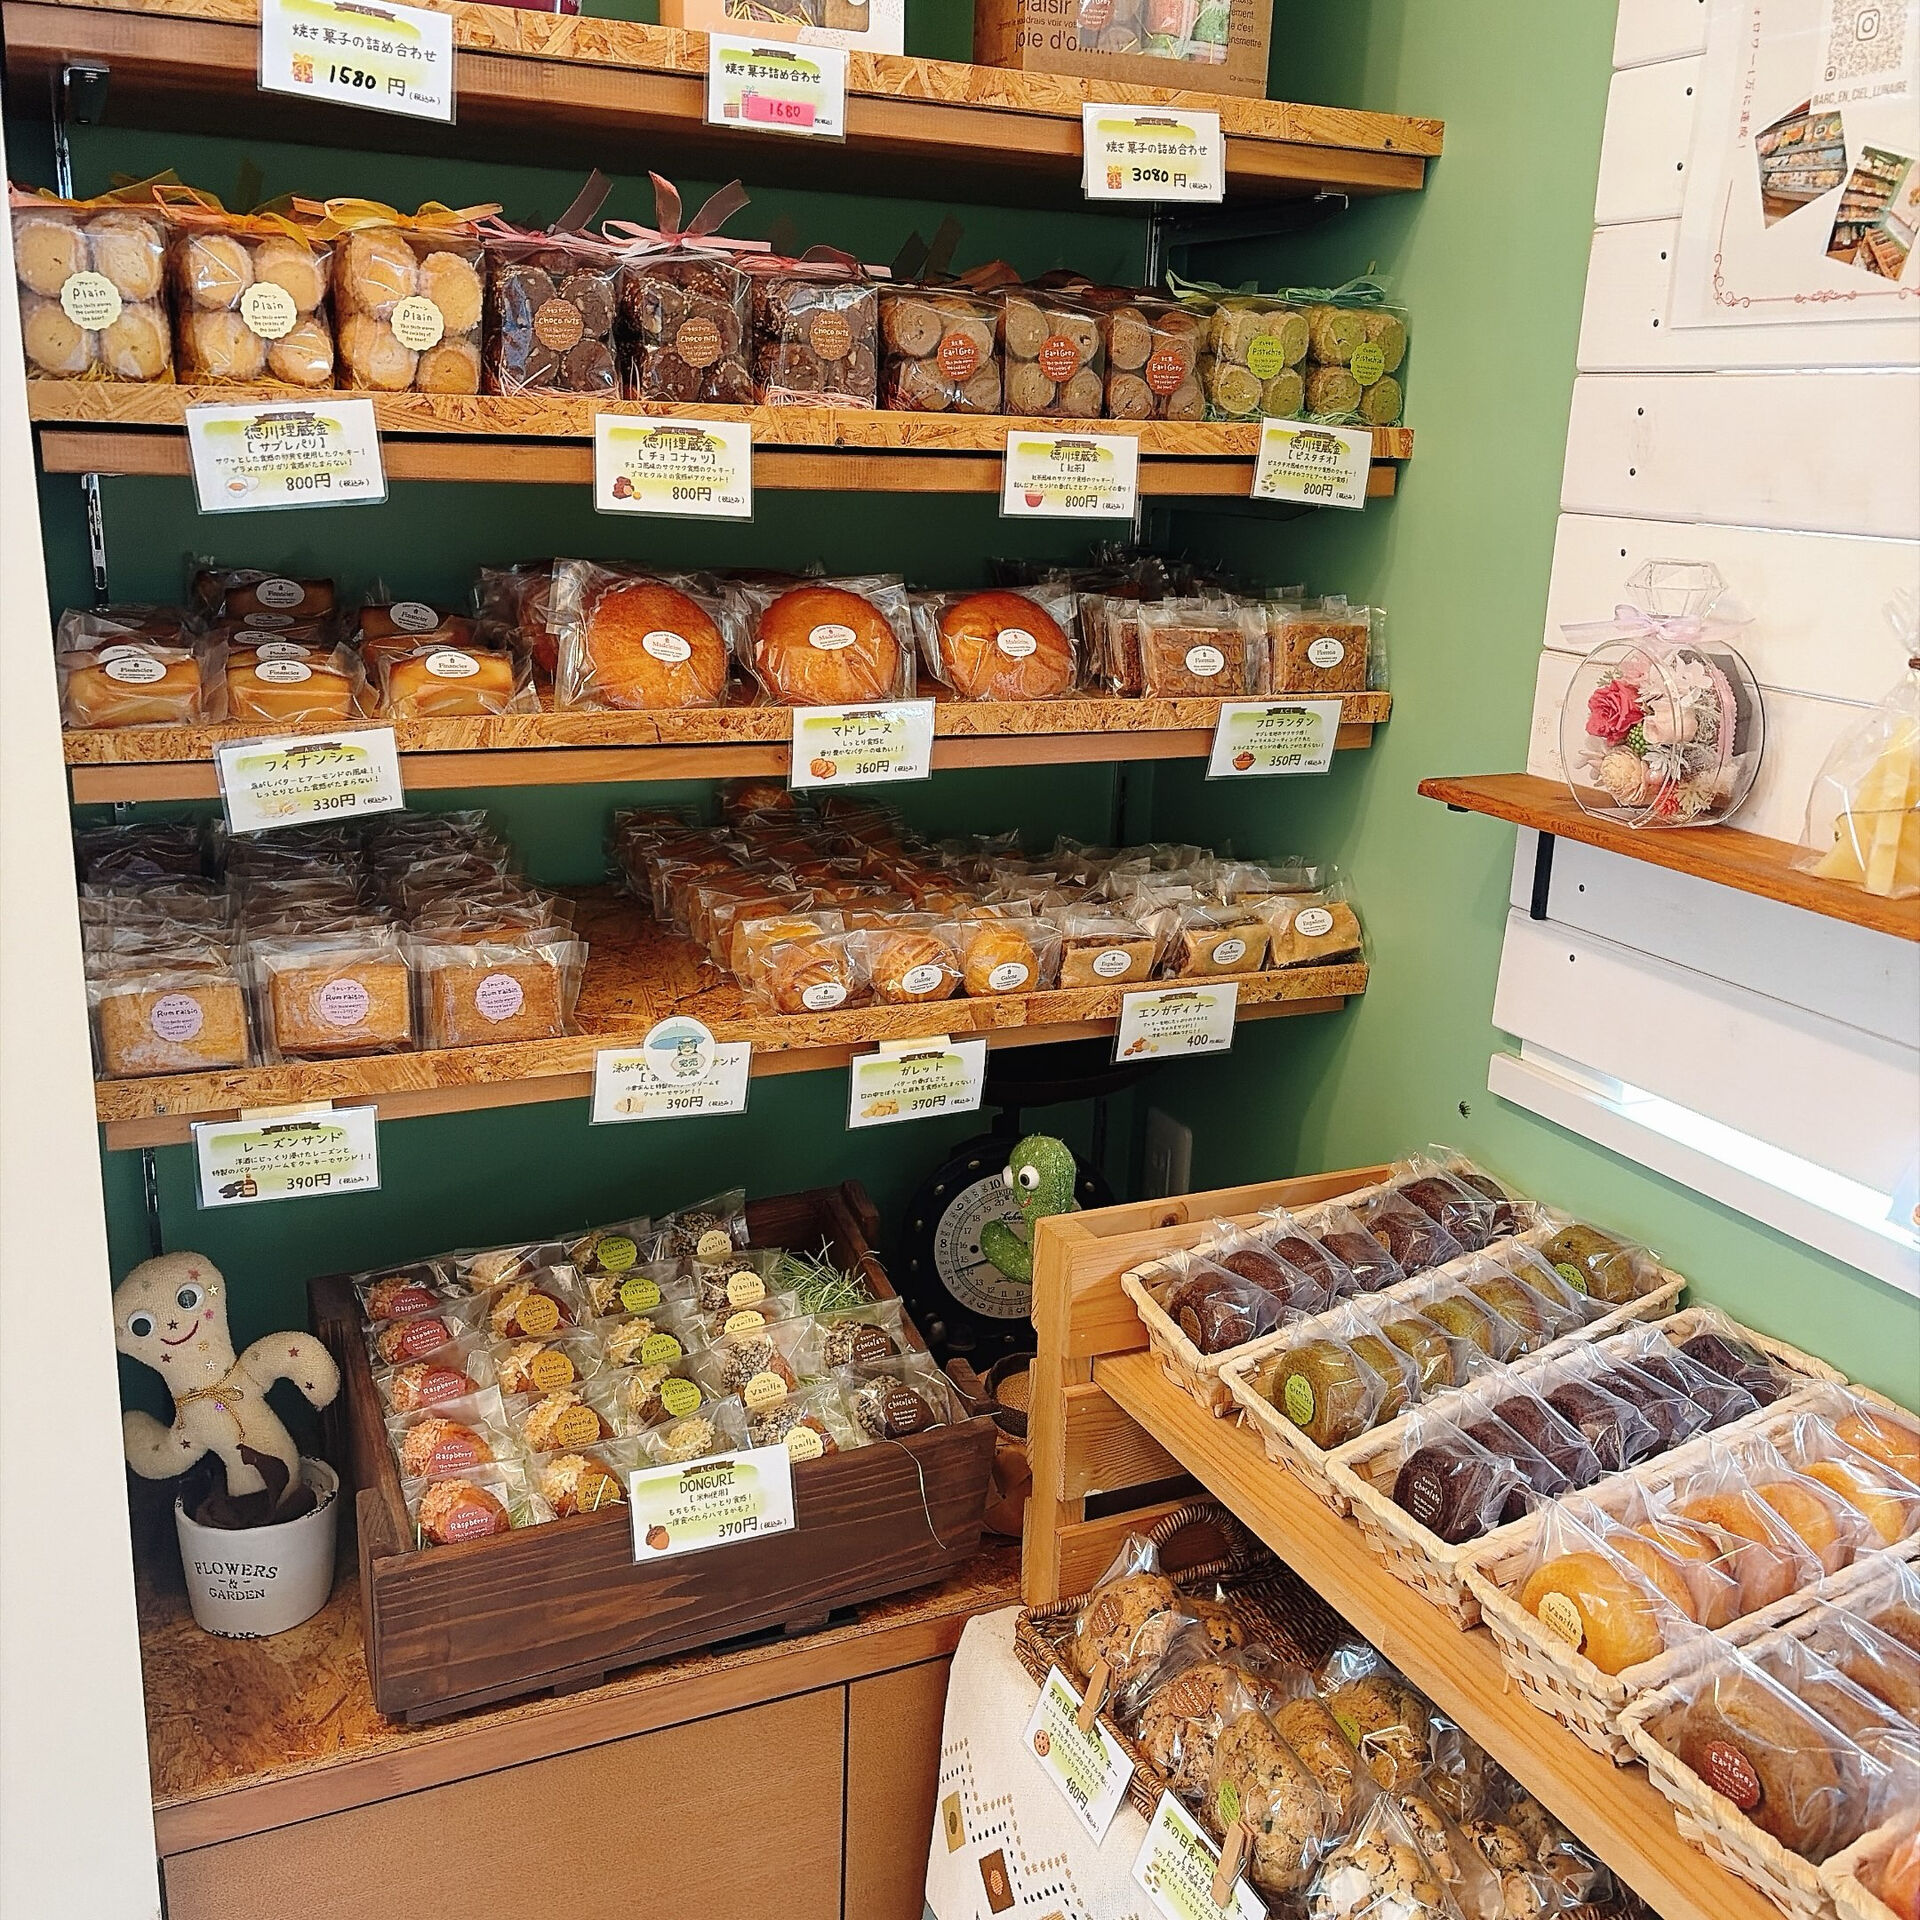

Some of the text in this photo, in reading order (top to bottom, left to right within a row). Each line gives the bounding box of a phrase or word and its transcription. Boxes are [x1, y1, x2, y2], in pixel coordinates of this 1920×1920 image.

[292, 23, 437, 62] 焼き菓子の詰め合わせ
[1015, 28, 1043, 53] joie
[329, 64, 376, 89] 1580
[387, 77, 406, 97] 円
[725, 63, 821, 83] 焼き菓子詰め合わせ
[769, 102, 801, 118] 1680
[1106, 141, 1209, 157] 焼き菓子の詰め合わせ
[1131, 167, 1170, 184] 3080
[1173, 172, 1187, 189] 円
[72, 287, 106, 299] Plain
[252, 299, 284, 311] Plain
[402, 309, 433, 322] Plain
[244, 421, 330, 440] 徳川埋蔵金
[642, 435, 717, 453] 徳川埋蔵金
[1290, 437, 1342, 455] 徳川埋蔵金
[637, 449, 716, 465] 【チョコナッツ】
[1050, 449, 1101, 462] 徳川埋蔵金
[1288, 449, 1338, 465] 【ピスタチオ】
[286, 473, 331, 491] 800円
[1303, 482, 1333, 497] 800円
[672, 486, 712, 501] 800円
[1065, 495, 1098, 508] 800円
[832, 723, 893, 737] マドレーヌ
[1256, 718, 1315, 729] フロランタン
[265, 752, 357, 772] フィナンシェ
[855, 760, 890, 774] 360円
[1268, 754, 1302, 767] 350円
[313, 794, 356, 811] 330円
[325, 993, 343, 1001] Rum
[481, 990, 497, 998] Rum
[156, 1009, 175, 1018] Rum
[1138, 1001, 1214, 1019] エンガディナー
[1187, 1034, 1209, 1047] 400
[900, 1062, 944, 1076] ガレット
[666, 1096, 704, 1109] 390円
[911, 1095, 947, 1111] 370円
[243, 1131, 343, 1153] レーズンサンド
[286, 1172, 331, 1190] 390円
[701, 1239, 727, 1253] Vanilla
[732, 1282, 760, 1292] Vanilla
[394, 1301, 428, 1313] Raspberry
[523, 1304, 550, 1317] Almond
[729, 1317, 759, 1330] Vanilla
[406, 1326, 441, 1343] Raspberry
[856, 1337, 886, 1352] Chocolate
[538, 1362, 567, 1373] Almond
[423, 1378, 460, 1395] Raspberry
[750, 1382, 781, 1396] Vanilla
[888, 1398, 918, 1410] Chocolate
[563, 1418, 593, 1431] Almond
[787, 1437, 816, 1453] Vanilla
[435, 1450, 474, 1461] Raspberry
[679, 1471, 735, 1494] DONGURI
[689, 1488, 729, 1503] 【米粉使用】
[1414, 1481, 1440, 1505] Chocolate
[450, 1516, 490, 1531] Raspberry
[718, 1516, 757, 1538] 370円
[194, 1561, 278, 1579] FLOWERS
[209, 1587, 265, 1600] GARDEN
[1547, 1603, 1577, 1635] Vanilla
[1711, 1751, 1733, 1774] Earl
[1065, 1775, 1089, 1810] 480円
